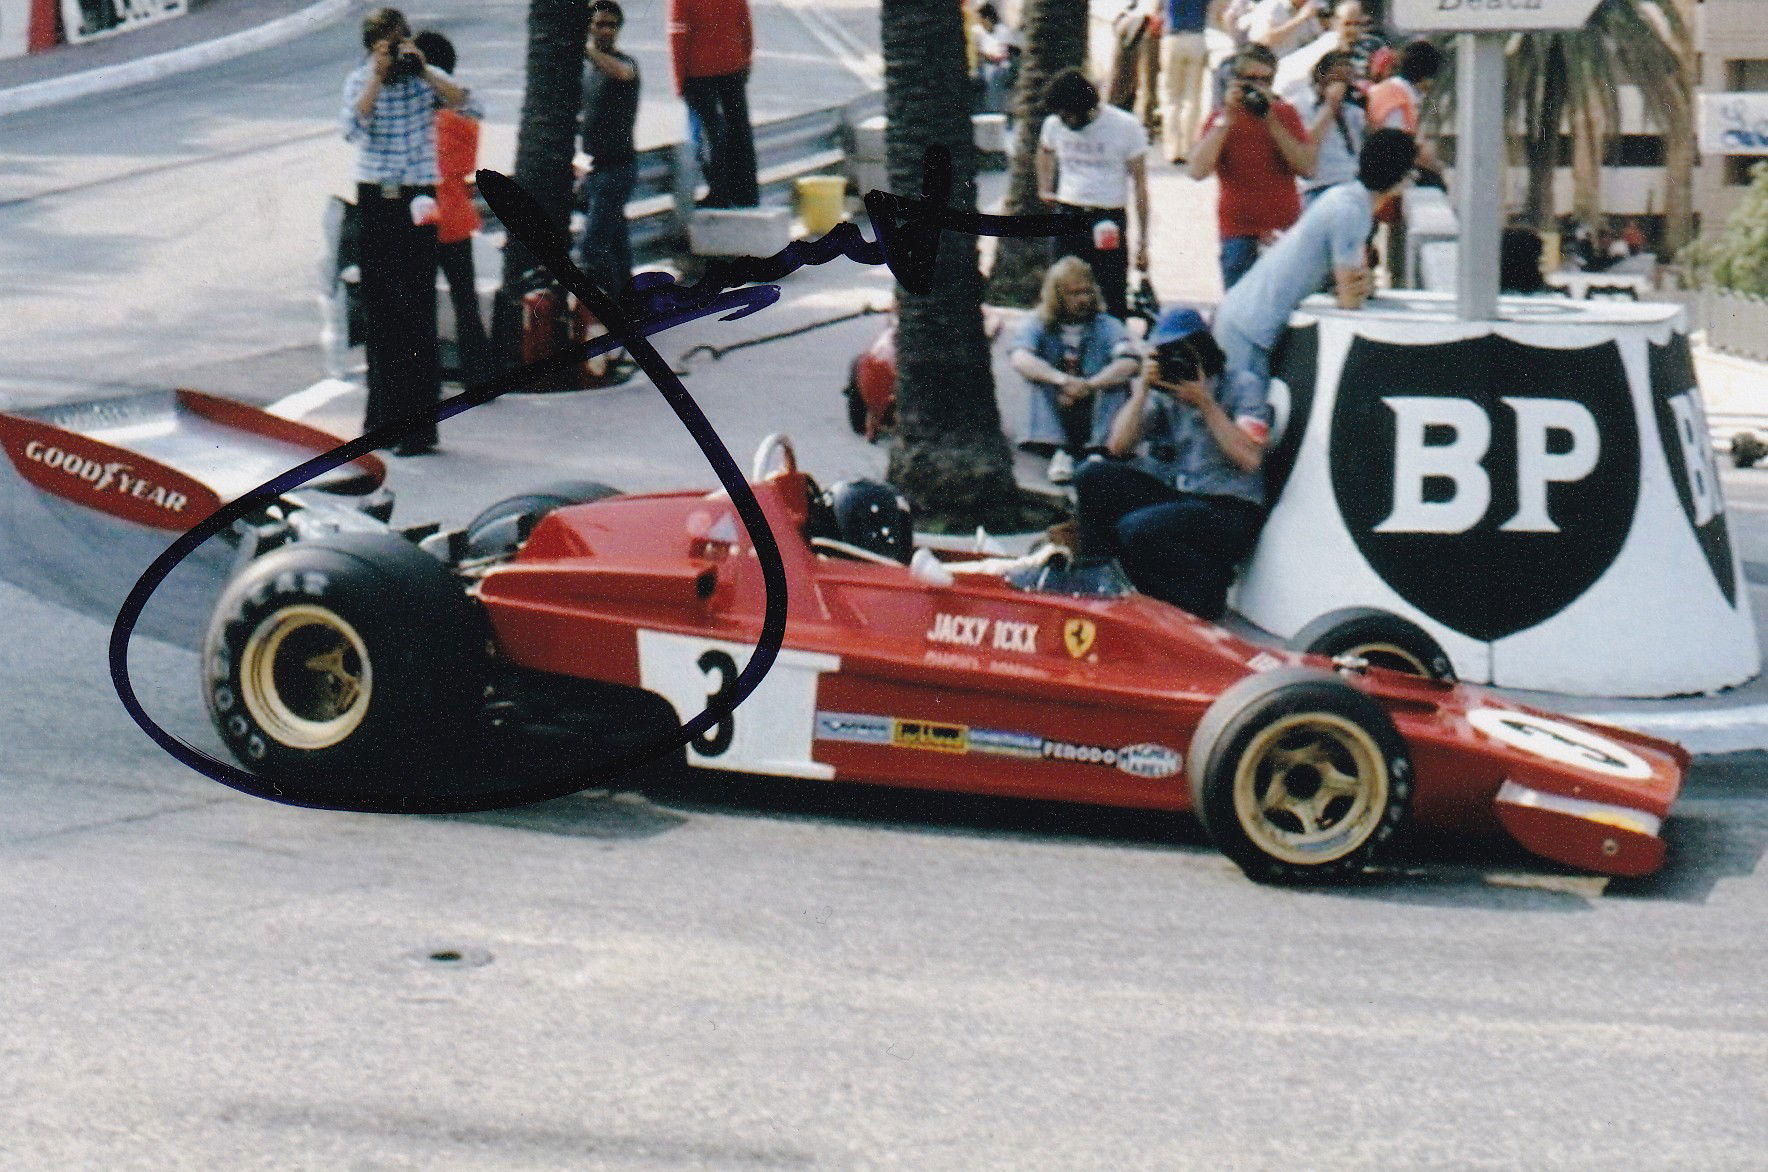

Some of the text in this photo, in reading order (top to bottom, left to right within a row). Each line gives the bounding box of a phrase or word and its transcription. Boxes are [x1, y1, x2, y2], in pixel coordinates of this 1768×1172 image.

[25, 440, 188, 513] GOODYEAR
[1372, 395, 1601, 534] BP
[926, 612, 1039, 654] JACKY ICKX
[689, 649, 739, 758] 3
[1044, 740, 1118, 765] FERODO
